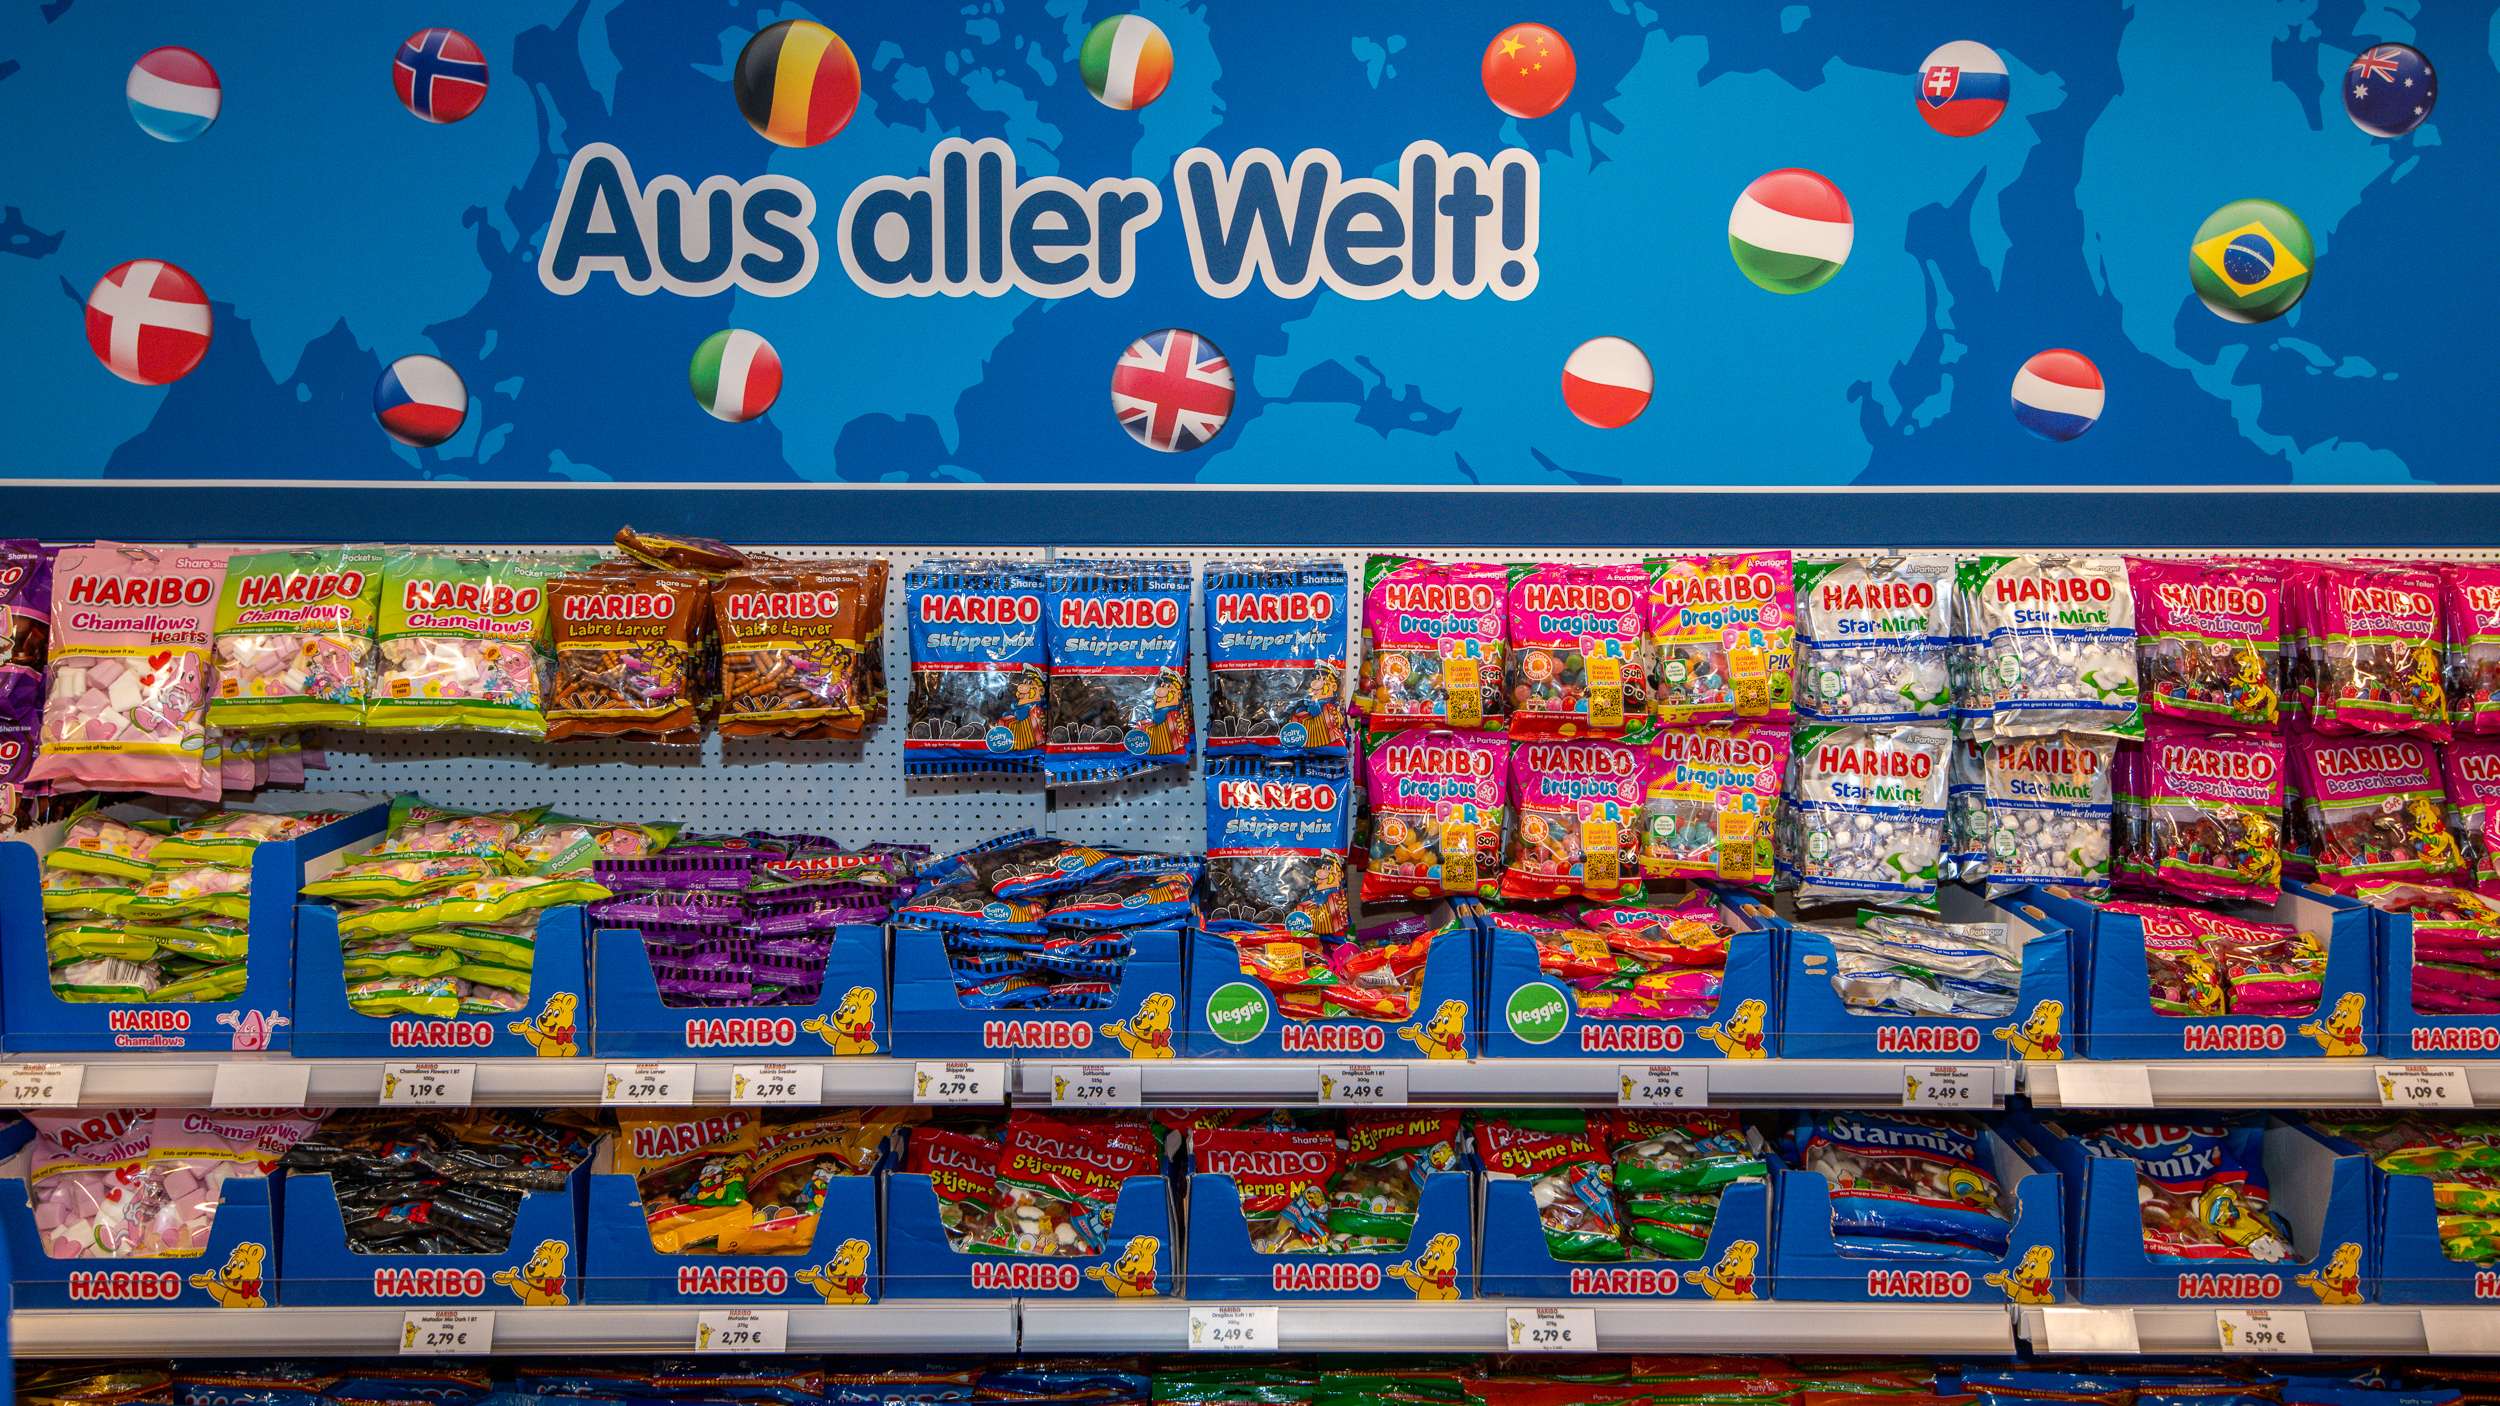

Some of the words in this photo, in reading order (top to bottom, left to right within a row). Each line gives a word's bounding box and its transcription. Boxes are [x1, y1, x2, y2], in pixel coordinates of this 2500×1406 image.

[543, 149, 813, 289] Aus
[843, 144, 1157, 292] aller
[1180, 146, 1534, 294] Welt!
[176, 558, 210, 568] Share
[513, 567, 543, 578] Pocket
[1010, 579, 1037, 588] Share
[1150, 581, 1176, 590] Share
[1303, 575, 1330, 584] Share
[1663, 574, 1776, 606] HARIBO
[2254, 576, 2276, 584] Teilen
[69, 577, 212, 606] HARIBO
[1386, 584, 1494, 612] HARIBO
[1524, 584, 1632, 612] HARIBO
[1822, 582, 1934, 612] HARIBO
[1996, 578, 2112, 604] HARIBO
[238, 607, 350, 624] Chamallows
[921, 595, 1041, 624] HARIBO
[1060, 598, 1178, 628] HARIBO
[1217, 593, 1333, 624] HARIBO
[1680, 606, 1760, 630] Dragibus
[1763, 608, 1778, 617] 50
[2015, 609, 2050, 623] Star
[2060, 608, 2108, 625] Mint
[71, 613, 197, 632] Chamallows
[408, 614, 530, 632] Chamallows
[569, 624, 611, 637] Labre
[616, 624, 667, 637] Larver
[736, 624, 777, 638] Labre
[783, 623, 832, 637] Larver
[1400, 614, 1478, 638] Dragibus
[1481, 618, 1496, 629] 50
[1540, 614, 1618, 637] Dragibus
[1622, 618, 1636, 628] 50
[1838, 618, 1874, 634] Star
[1882, 616, 1928, 632] Mint
[2169, 612, 2264, 635] Beerentraum
[150, 631, 208, 645] Hearts
[927, 632, 1000, 651] Skipper
[1000, 631, 1035, 655] Mix
[1065, 636, 1137, 656] Skipper
[1138, 636, 1174, 660] Mix
[1222, 631, 1294, 650] Skipper
[1294, 630, 1326, 656] Mix
[1722, 627, 1794, 650] PARTY
[1482, 670, 1500, 680] Soft
[1624, 668, 1642, 678] Soft
[1388, 746, 1494, 777] HARIBO
[1819, 744, 1932, 778] HARIBO
[1542, 778, 1618, 799] Dragibus
[1676, 764, 1754, 791] Dragibus
[2165, 777, 2270, 800] Beerentraum
[2326, 773, 2428, 794] Beerentraum
[1400, 778, 1476, 802] Dragibus
[1480, 784, 1495, 794] 50
[1832, 782, 1868, 800] Star
[1876, 785, 1922, 803] Mint
[2050, 782, 2091, 799] Mint
[1715, 792, 1780, 816] PARTY
[2055, 808, 2084, 818] Menthe
[2084, 810, 2111, 818] Intense
[1226, 816, 1296, 837] Skipper
[1296, 818, 1332, 840] Mix
[1876, 812, 1909, 823] Menthe
[1910, 815, 1938, 825] Intense
[1478, 836, 1496, 846] Soft
[109, 1010, 190, 1032] HARIBO
[1212, 1001, 1263, 1026] Veggie
[1510, 1000, 1563, 1026] Veggie
[115, 1034, 185, 1049] Chamallows
[390, 1021, 494, 1048] HARIBO
[686, 1019, 796, 1048] HARIBO
[984, 1020, 1093, 1049] HARIBO
[1281, 1025, 1384, 1052] HARIBO
[1582, 1025, 1684, 1052] HARIBO
[1877, 1026, 1980, 1052] HARIBO
[2184, 1024, 2286, 1052] HARIBO
[15, 1086, 39, 1099] 1,79
[43, 1086, 52, 1097] €
[410, 1084, 431, 1097] 1,19
[436, 1085, 446, 1096] €
[628, 1085, 654, 1098] 2,79
[659, 1085, 668, 1096] €
[757, 1085, 782, 1097] 2,79
[787, 1085, 796, 1096] €
[940, 1083, 964, 1095] 2,79
[969, 1084, 978, 1094] €
[1078, 1087, 1102, 1099] 2,79
[1107, 1087, 1116, 1098] €
[1343, 1086, 1370, 1098] 2,49
[1374, 1086, 1384, 1098] €
[1643, 1086, 1670, 1099] 2,49
[1675, 1086, 1684, 1098] €
[1928, 1088, 1956, 1100] 2,49
[1960, 1088, 1969, 1098] €
[2405, 1088, 2432, 1100] 1,09
[2437, 1088, 2446, 1098] €
[184, 1113, 300, 1143] Chamallows
[1351, 1122, 1404, 1152] Stjerne
[1408, 1118, 1440, 1135] Mix
[1832, 1115, 1966, 1160] Starmix
[1292, 1135, 1318, 1144] Share
[1319, 1136, 1332, 1144] Size
[1501, 1144, 1566, 1169] Stjerne
[1013, 1153, 1082, 1180] Stjerne
[1086, 1170, 1120, 1190] Mix
[70, 1272, 181, 1300] HARIBO
[374, 1268, 485, 1296] HARIBO
[678, 1266, 788, 1294] HARIBO
[972, 1262, 1080, 1290] HARIBO
[1273, 1263, 1381, 1291] HARIBO
[1570, 1268, 1679, 1295] HARIBO
[1868, 1270, 1971, 1297] HARIBO
[2178, 1272, 2282, 1300] HARIBO
[427, 1333, 453, 1345] 2,79
[458, 1333, 467, 1344] €
[722, 1332, 748, 1344] 2,79
[752, 1332, 762, 1343] €
[1213, 1329, 1240, 1342] 2,49
[1245, 1329, 1254, 1340] €
[1533, 1330, 1558, 1342] 2,79
[1563, 1330, 1572, 1341] €
[2246, 1332, 2272, 1344] 5,99
[2276, 1332, 2286, 1344] €
[1747, 1383, 1765, 1394] Party
[1872, 1377, 1891, 1386] Party
